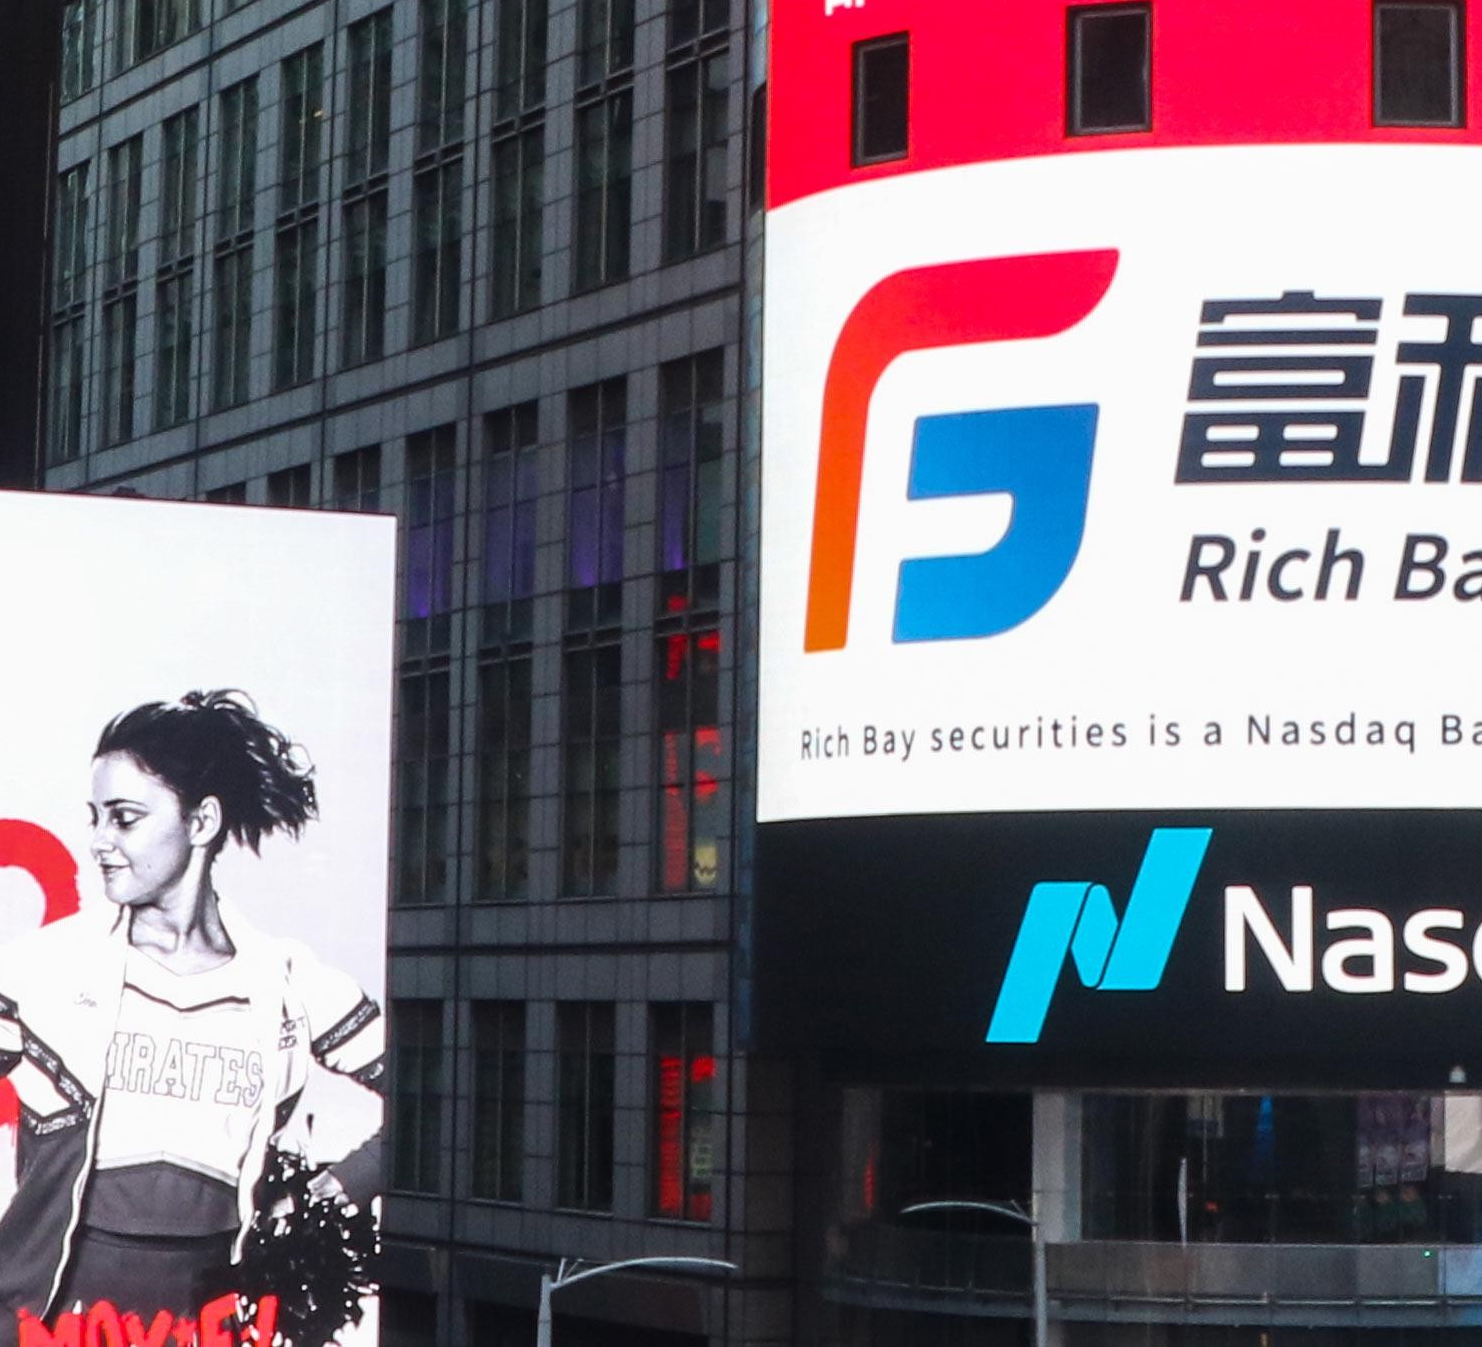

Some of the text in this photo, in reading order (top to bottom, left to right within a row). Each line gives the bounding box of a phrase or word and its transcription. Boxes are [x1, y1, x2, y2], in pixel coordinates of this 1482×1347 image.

[1181, 529, 1364, 601] Rich
[801, 726, 849, 759] Rich
[864, 725, 916, 760] Bay
[931, 715, 1127, 752] securities
[1149, 714, 1181, 746] is
[1204, 722, 1222, 746] a
[1248, 713, 1416, 753] Nasdaq
[106, 1031, 266, 1108] IRATES
